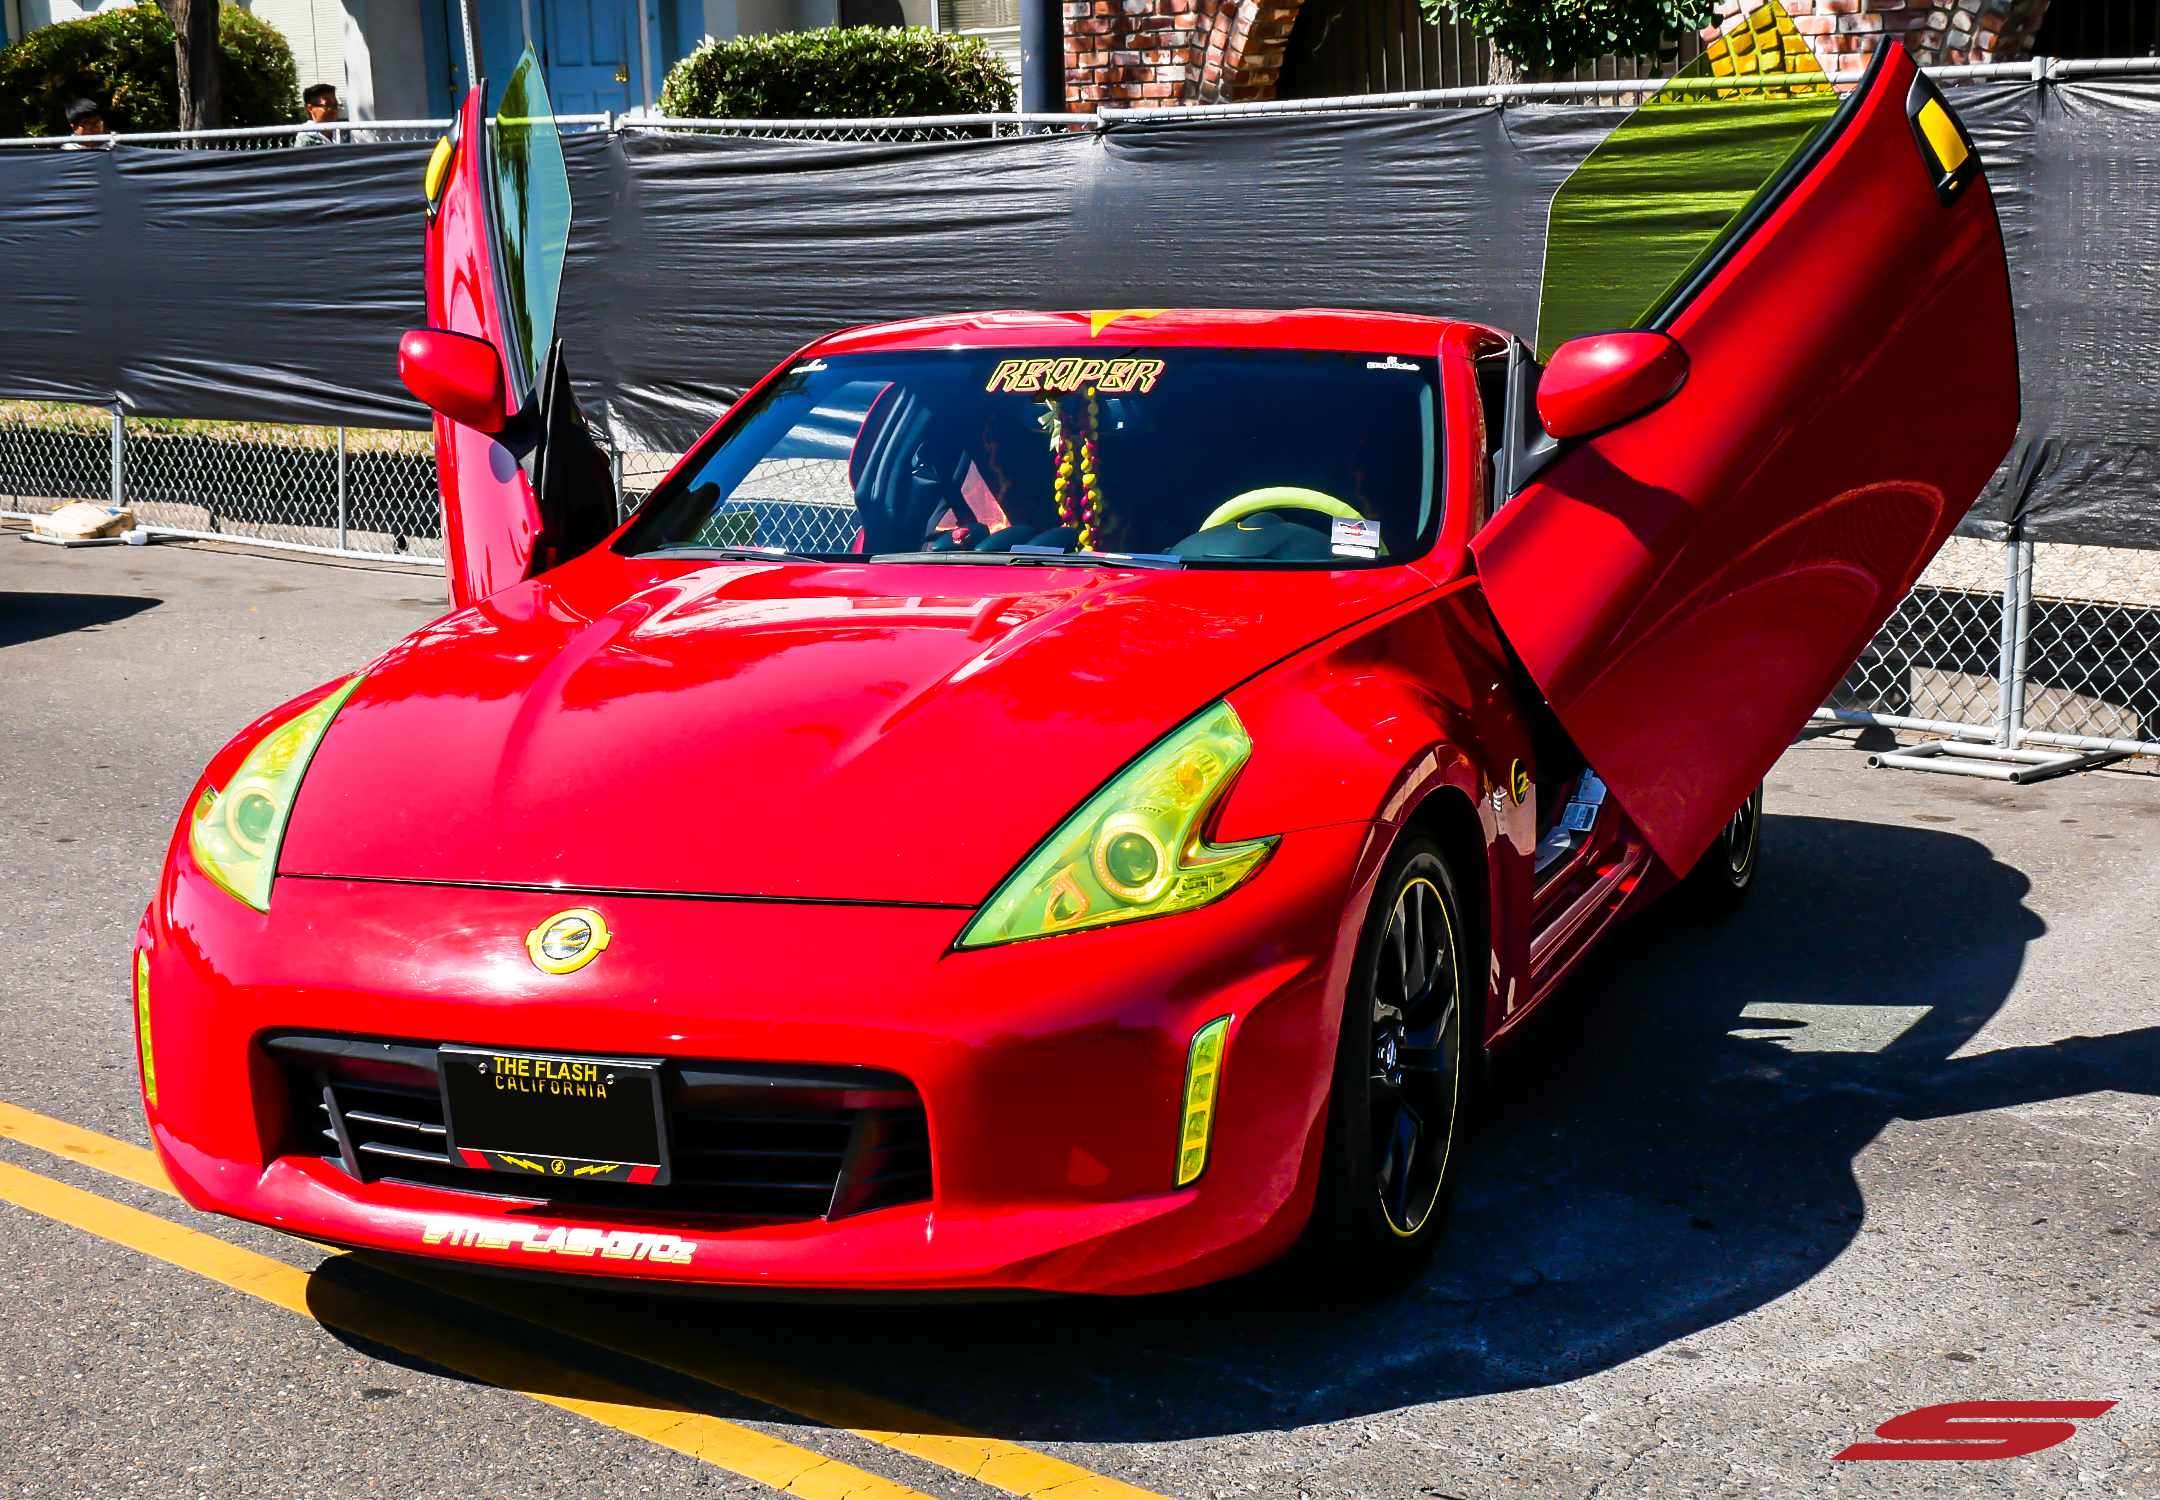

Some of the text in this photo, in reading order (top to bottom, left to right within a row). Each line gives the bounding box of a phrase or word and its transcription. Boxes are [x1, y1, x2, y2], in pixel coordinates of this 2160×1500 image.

[985, 357, 1165, 393] REAPER
[493, 1056, 597, 1082] THE FLASH
[495, 1075, 607, 1099] CALIFORNIA
